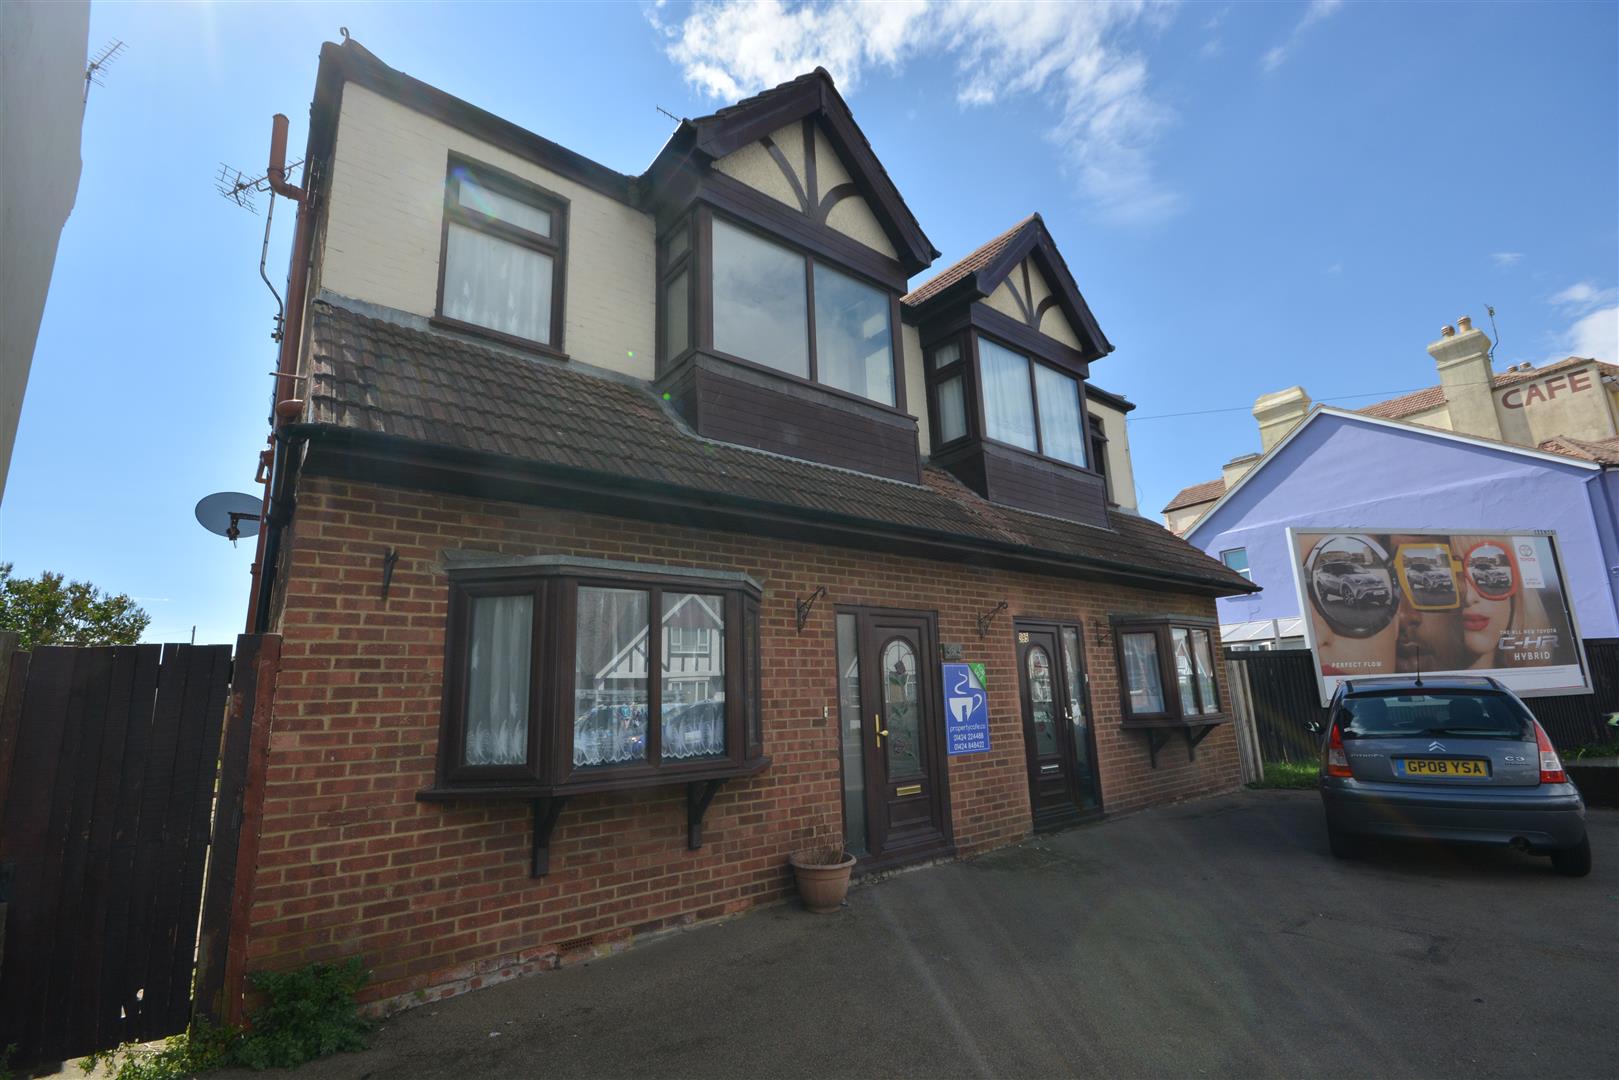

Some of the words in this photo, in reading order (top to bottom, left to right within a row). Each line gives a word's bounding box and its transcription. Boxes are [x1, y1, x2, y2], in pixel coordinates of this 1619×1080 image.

[1501, 368, 1592, 409] CAFE
[1498, 635, 1560, 650] C-HR
[1514, 651, 1550, 661] HYBRID
[1407, 760, 1448, 773] GP08
[1450, 761, 1483, 774] YSA
